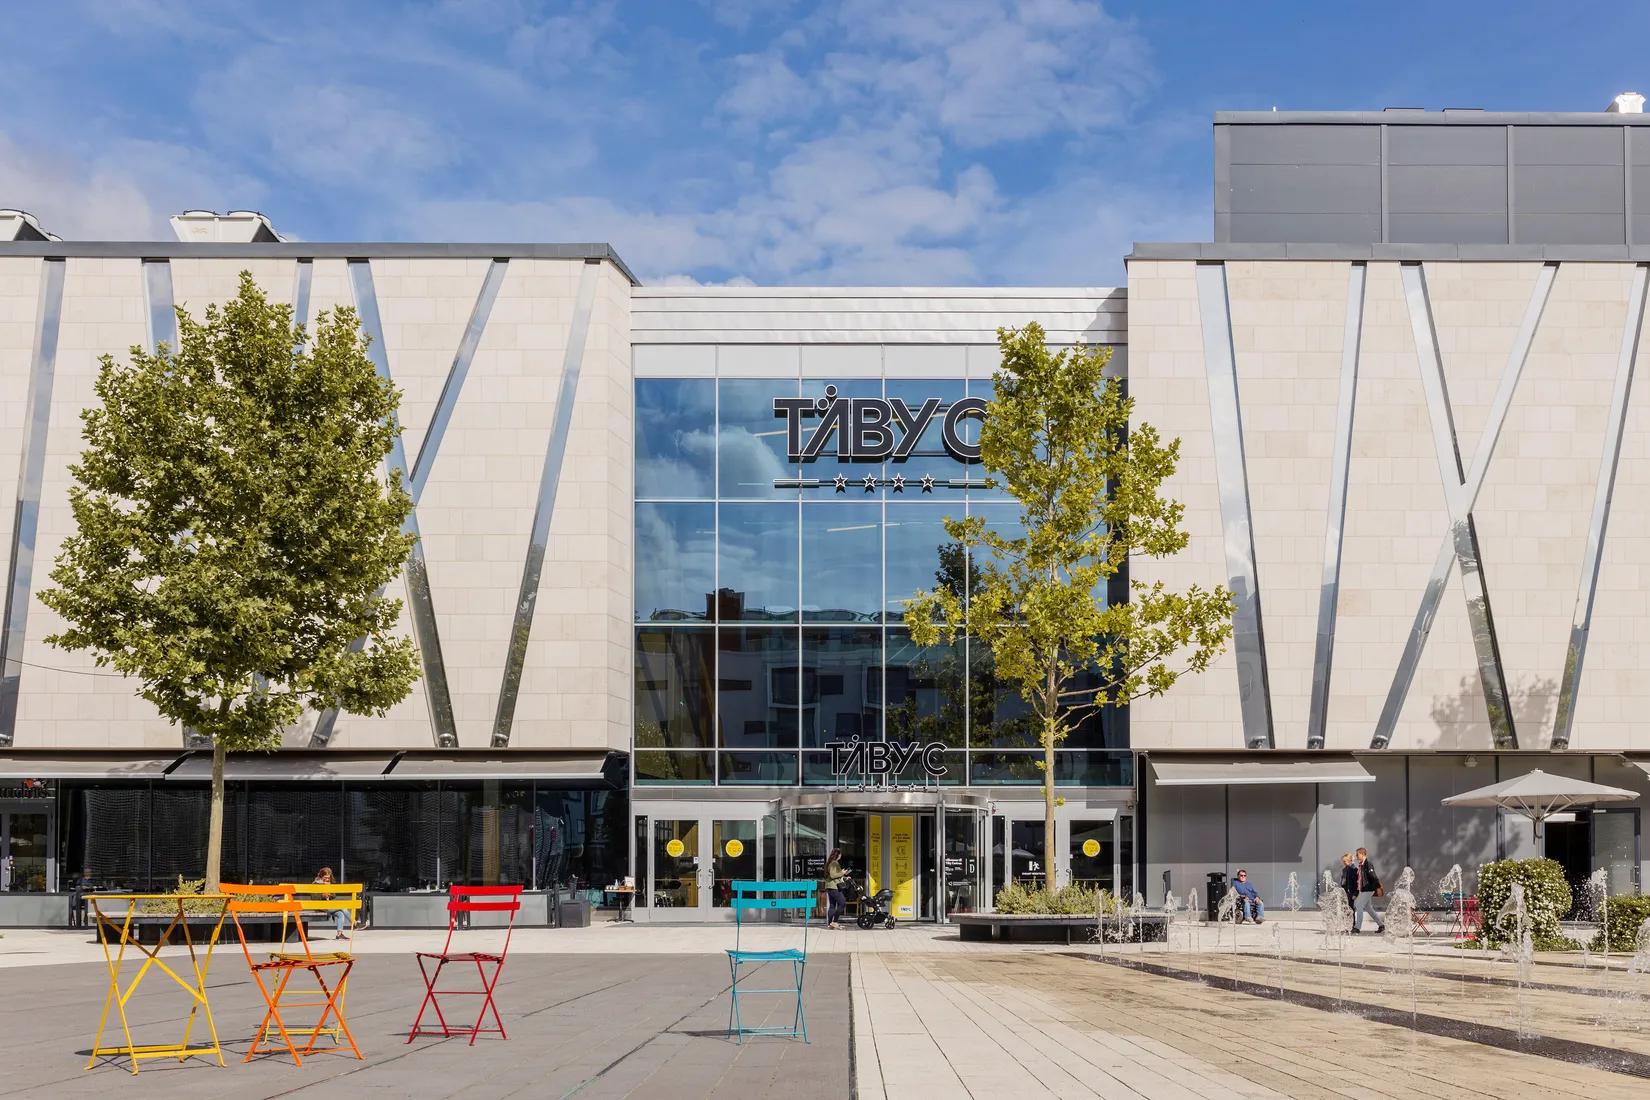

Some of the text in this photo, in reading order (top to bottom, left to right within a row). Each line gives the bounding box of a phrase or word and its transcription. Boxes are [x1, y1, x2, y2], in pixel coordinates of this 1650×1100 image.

[773, 384, 989, 460] TÄBY C
[824, 734, 948, 776] TÄBY C
[969, 863, 976, 874] D
